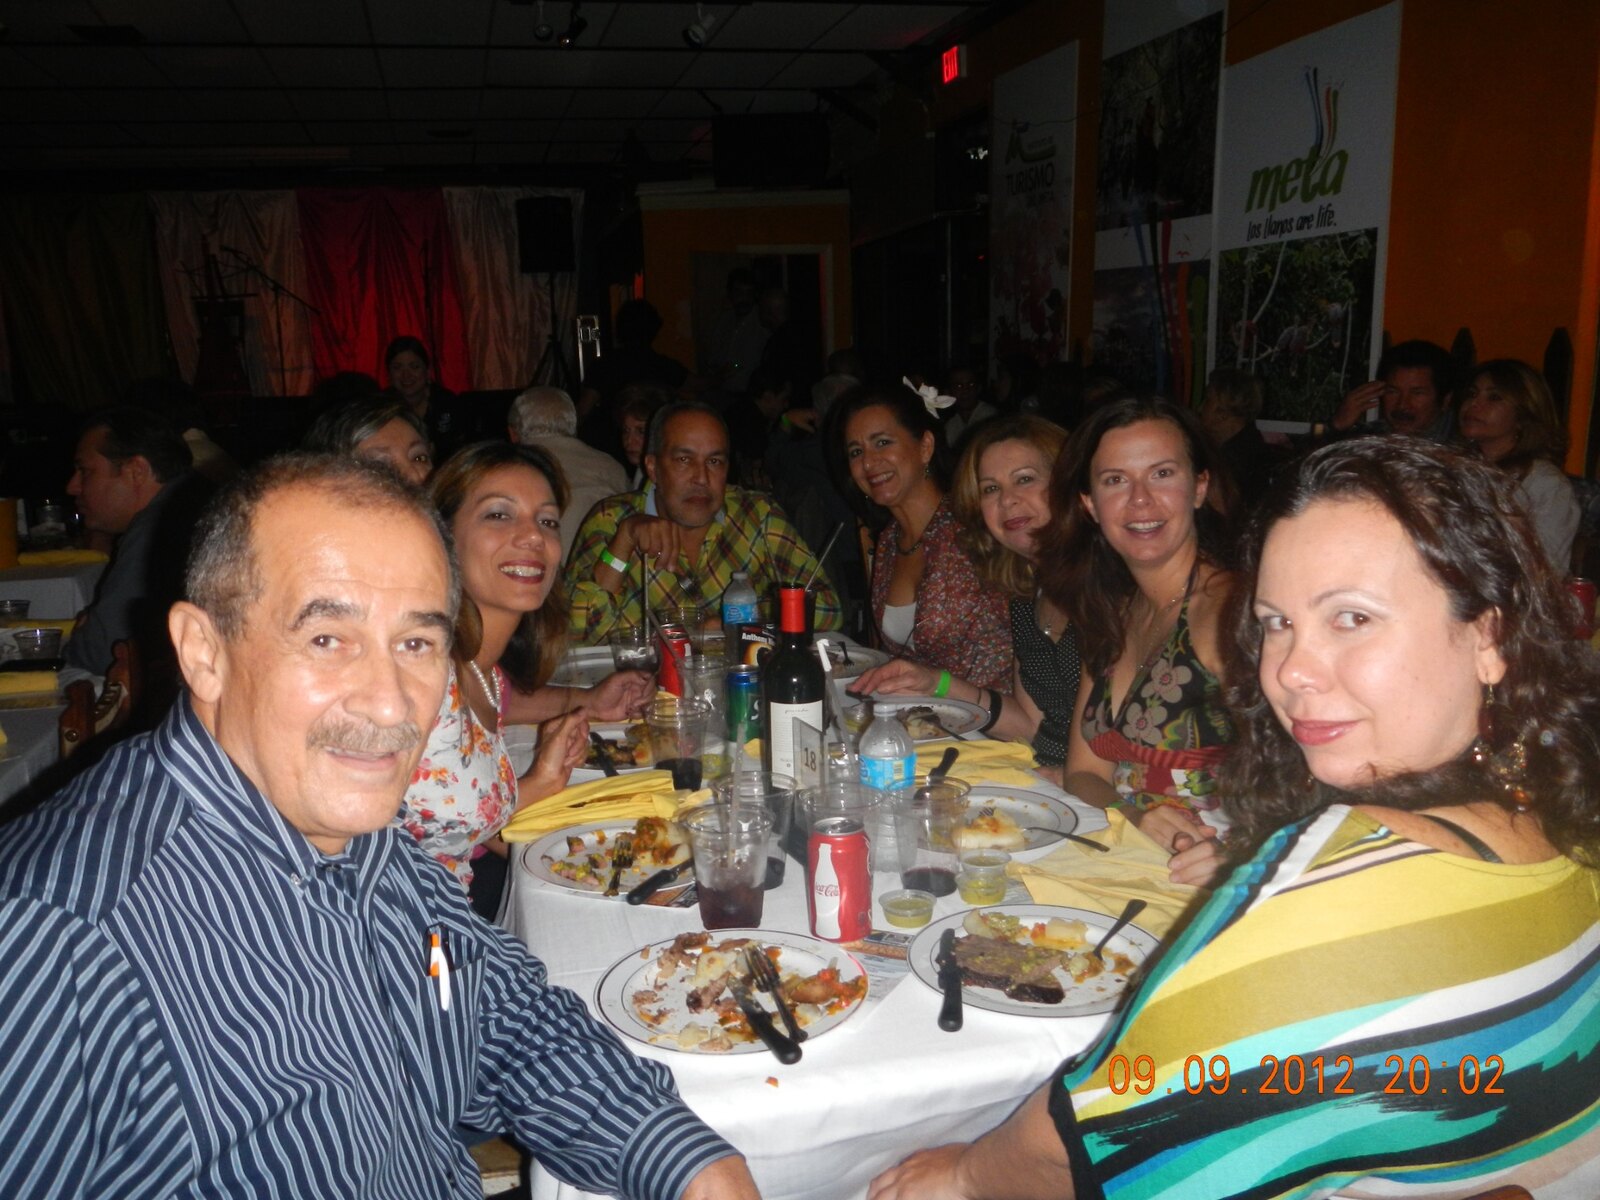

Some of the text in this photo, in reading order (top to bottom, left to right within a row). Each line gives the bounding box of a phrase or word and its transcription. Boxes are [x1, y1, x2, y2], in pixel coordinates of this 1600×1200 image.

[943, 46, 959, 83] EXIT
[1006, 161, 1056, 196] TURISMO
[1245, 144, 1349, 214] meta
[1296, 213, 1314, 231] are
[804, 746, 817, 773] 18
